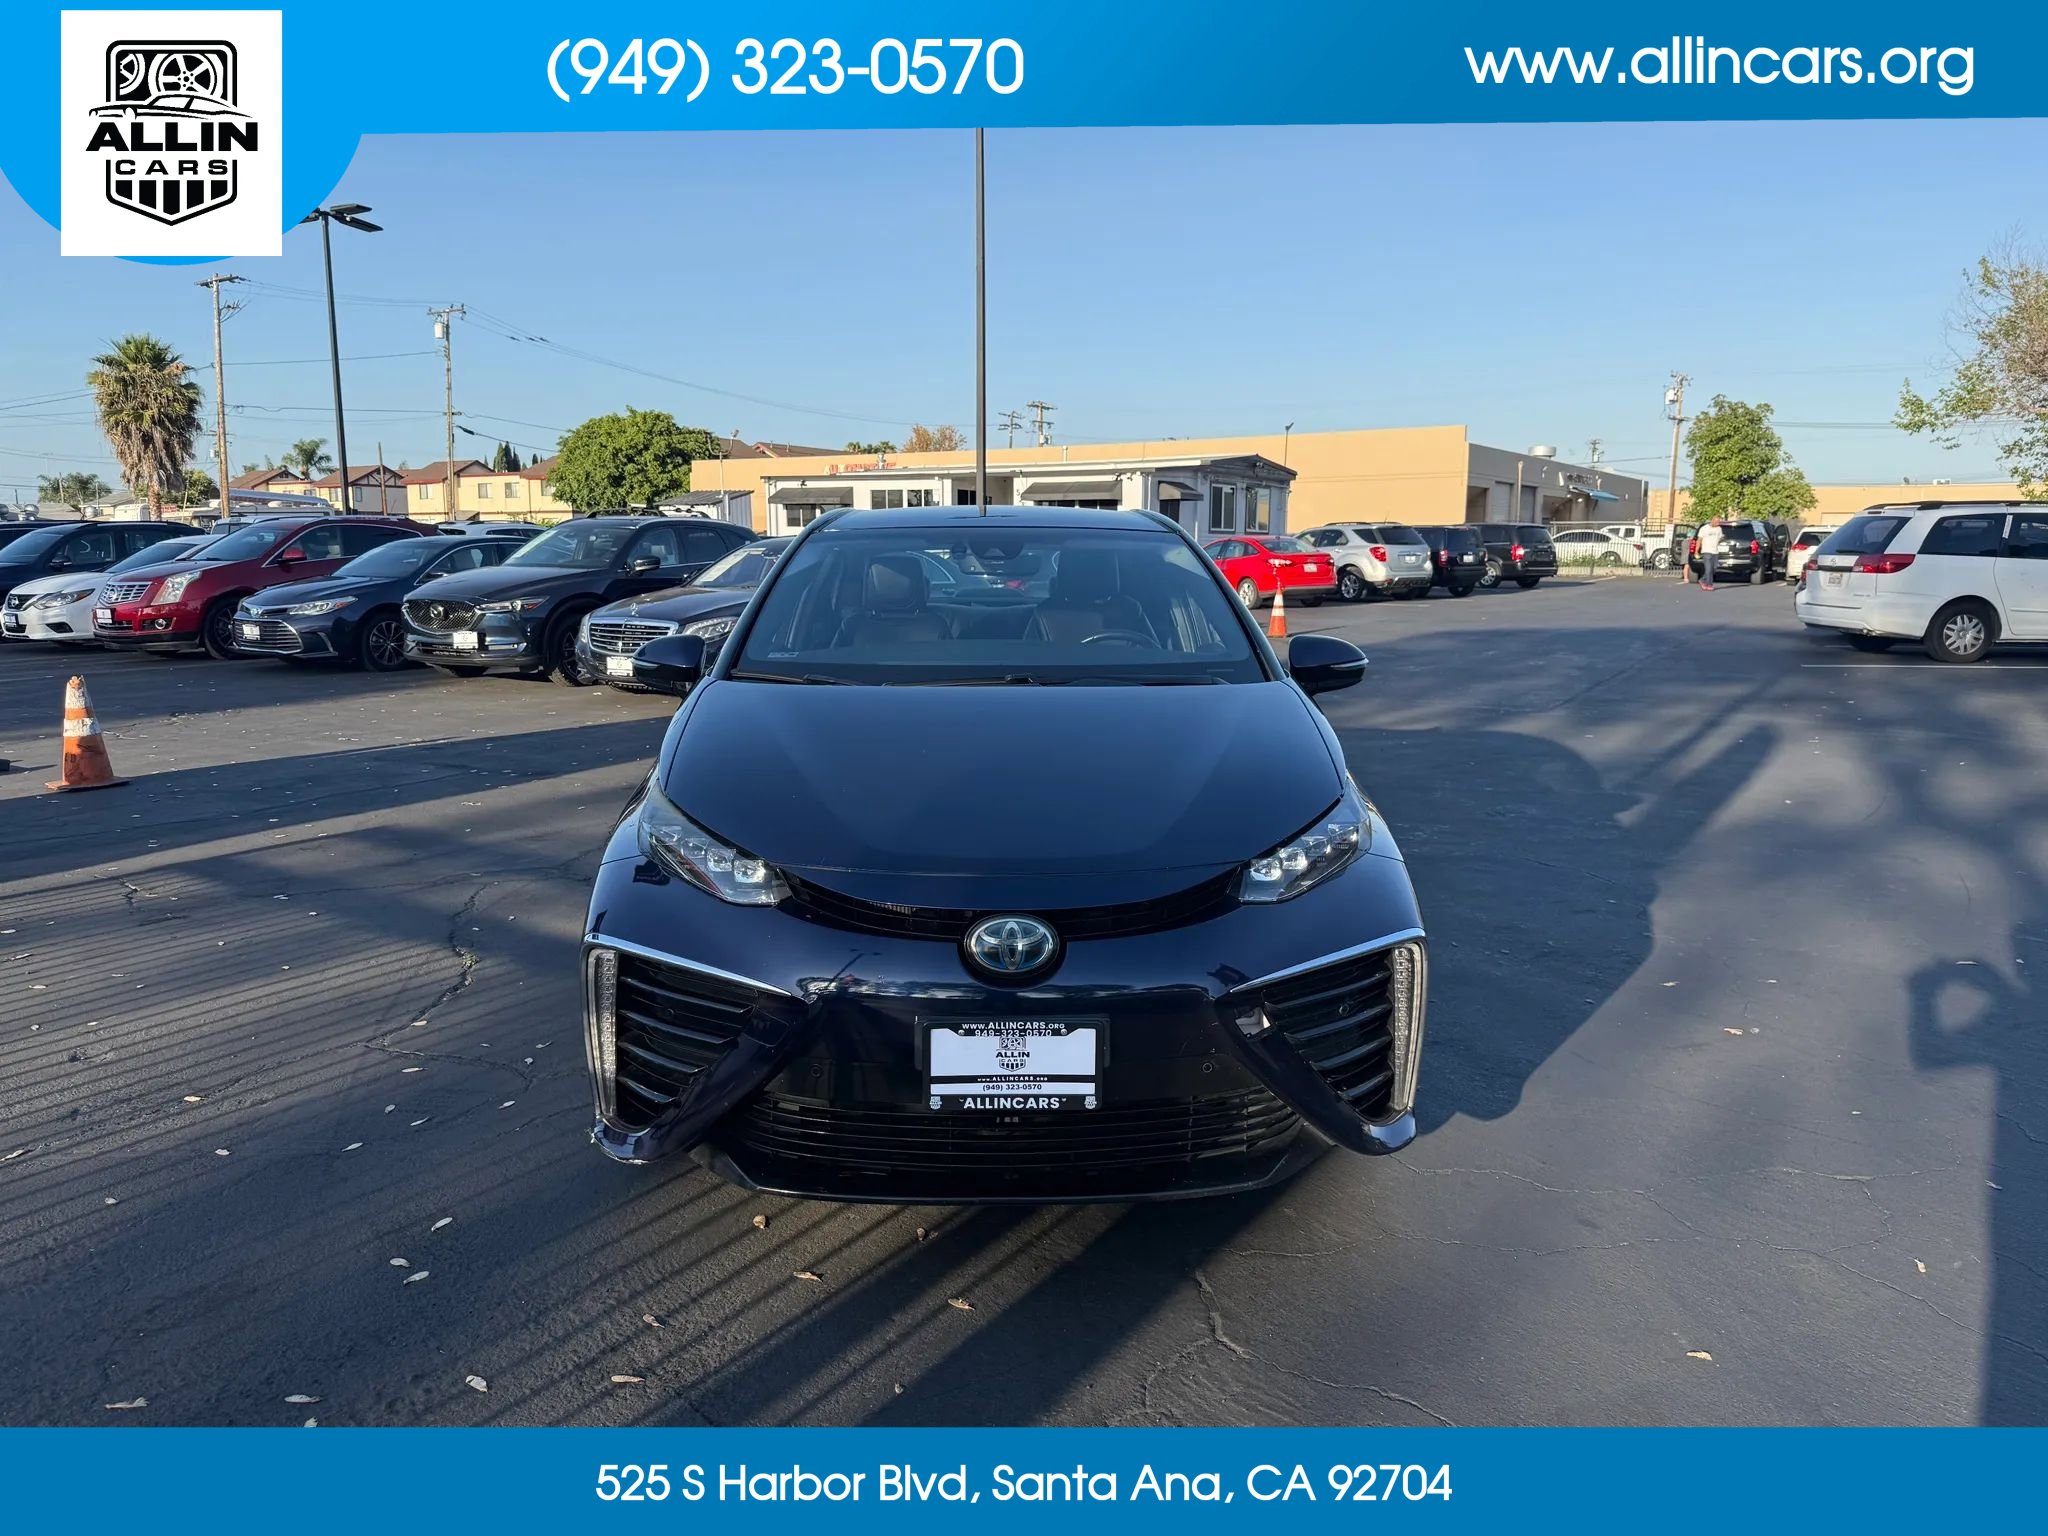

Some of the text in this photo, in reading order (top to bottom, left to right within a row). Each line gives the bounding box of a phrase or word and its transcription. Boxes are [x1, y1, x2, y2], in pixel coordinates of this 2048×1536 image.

[974, 1029, 1053, 1037] 949-323-0570
[982, 1084, 1004, 1092] (949)
[963, 1097, 1061, 1109] ALLINCARS
